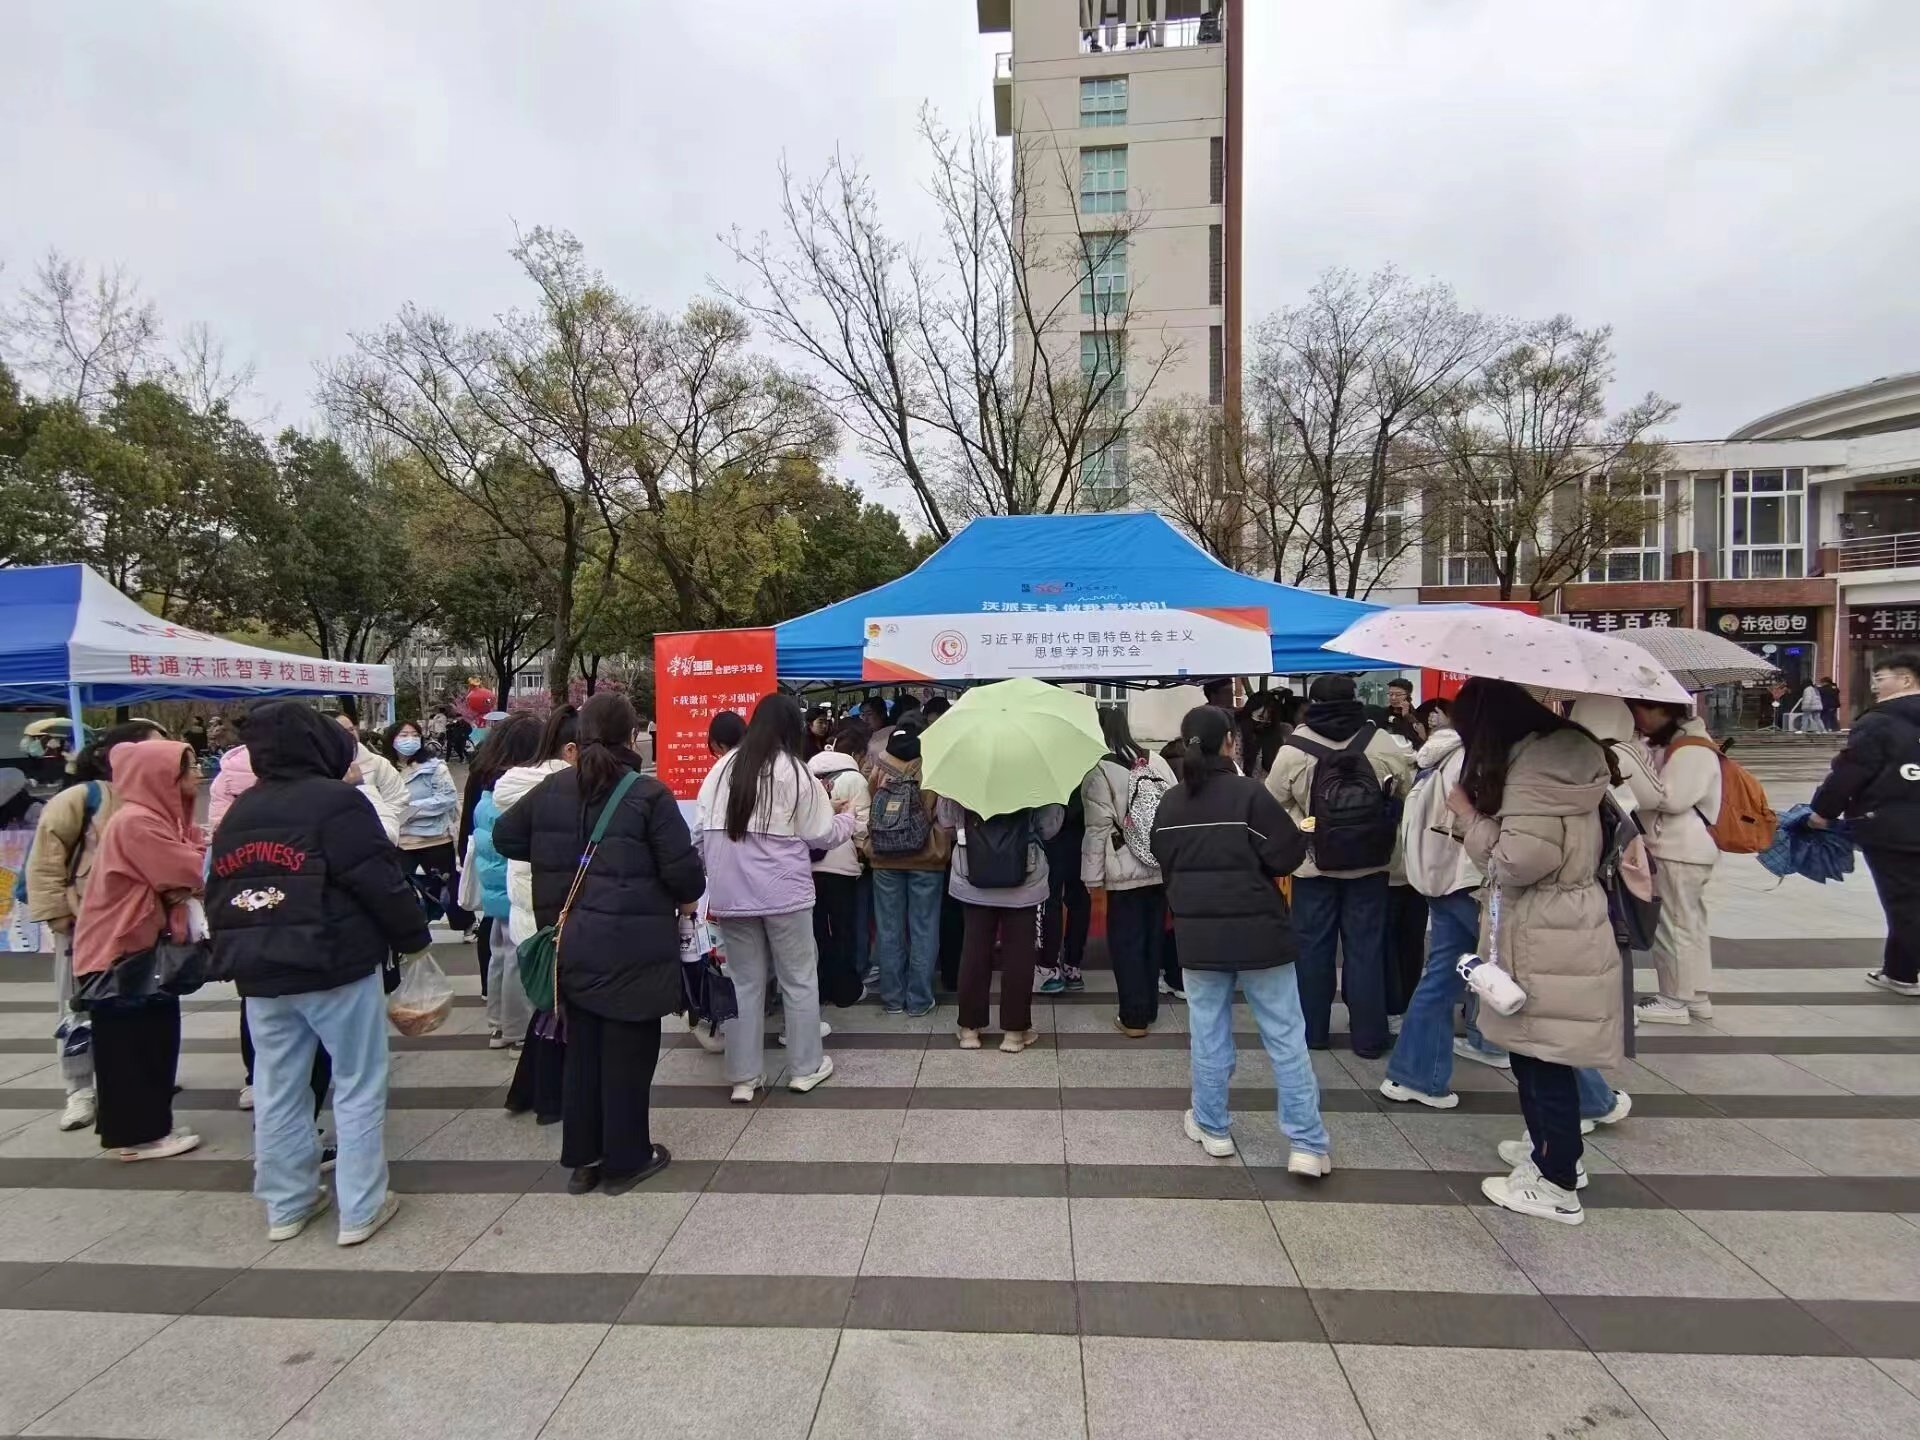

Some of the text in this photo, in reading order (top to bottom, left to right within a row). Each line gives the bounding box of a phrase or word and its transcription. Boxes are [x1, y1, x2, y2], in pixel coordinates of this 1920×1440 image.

[1871, 610, 1920, 631] 生活
[981, 629, 1195, 646] 习近平新时代中国特色社会主义
[1034, 645, 1142, 659] 思想学习研究会
[129, 654, 370, 686] 联通沃派智享校园新生活
[714, 663, 763, 675] 合肥学习平台
